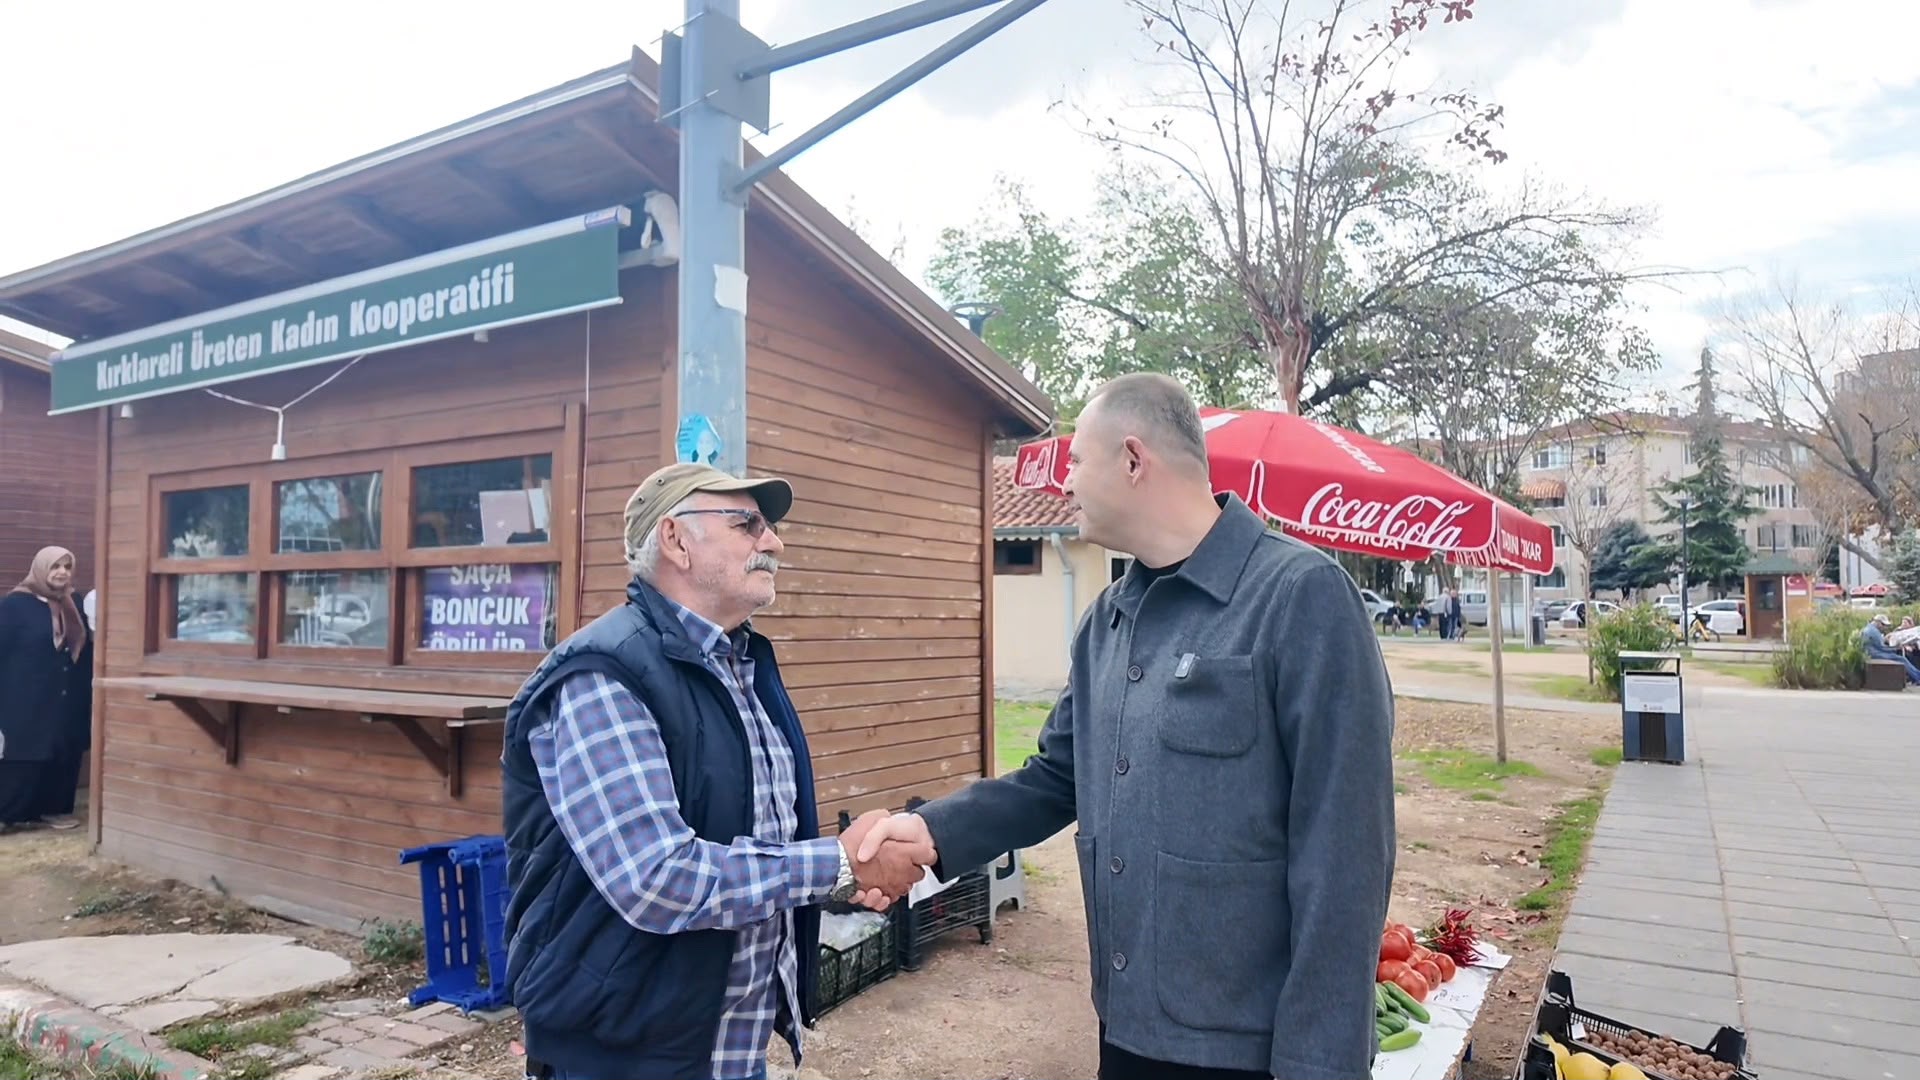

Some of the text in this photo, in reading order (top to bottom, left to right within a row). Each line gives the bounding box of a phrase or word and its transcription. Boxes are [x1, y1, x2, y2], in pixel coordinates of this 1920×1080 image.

[97, 262, 514, 391] Kırklareli Üreten Kadın Kooperatifi
[1300, 482, 1474, 549] Coca-Cola
[450, 565, 512, 593] SAÇA
[431, 597, 530, 625] BONCUK
